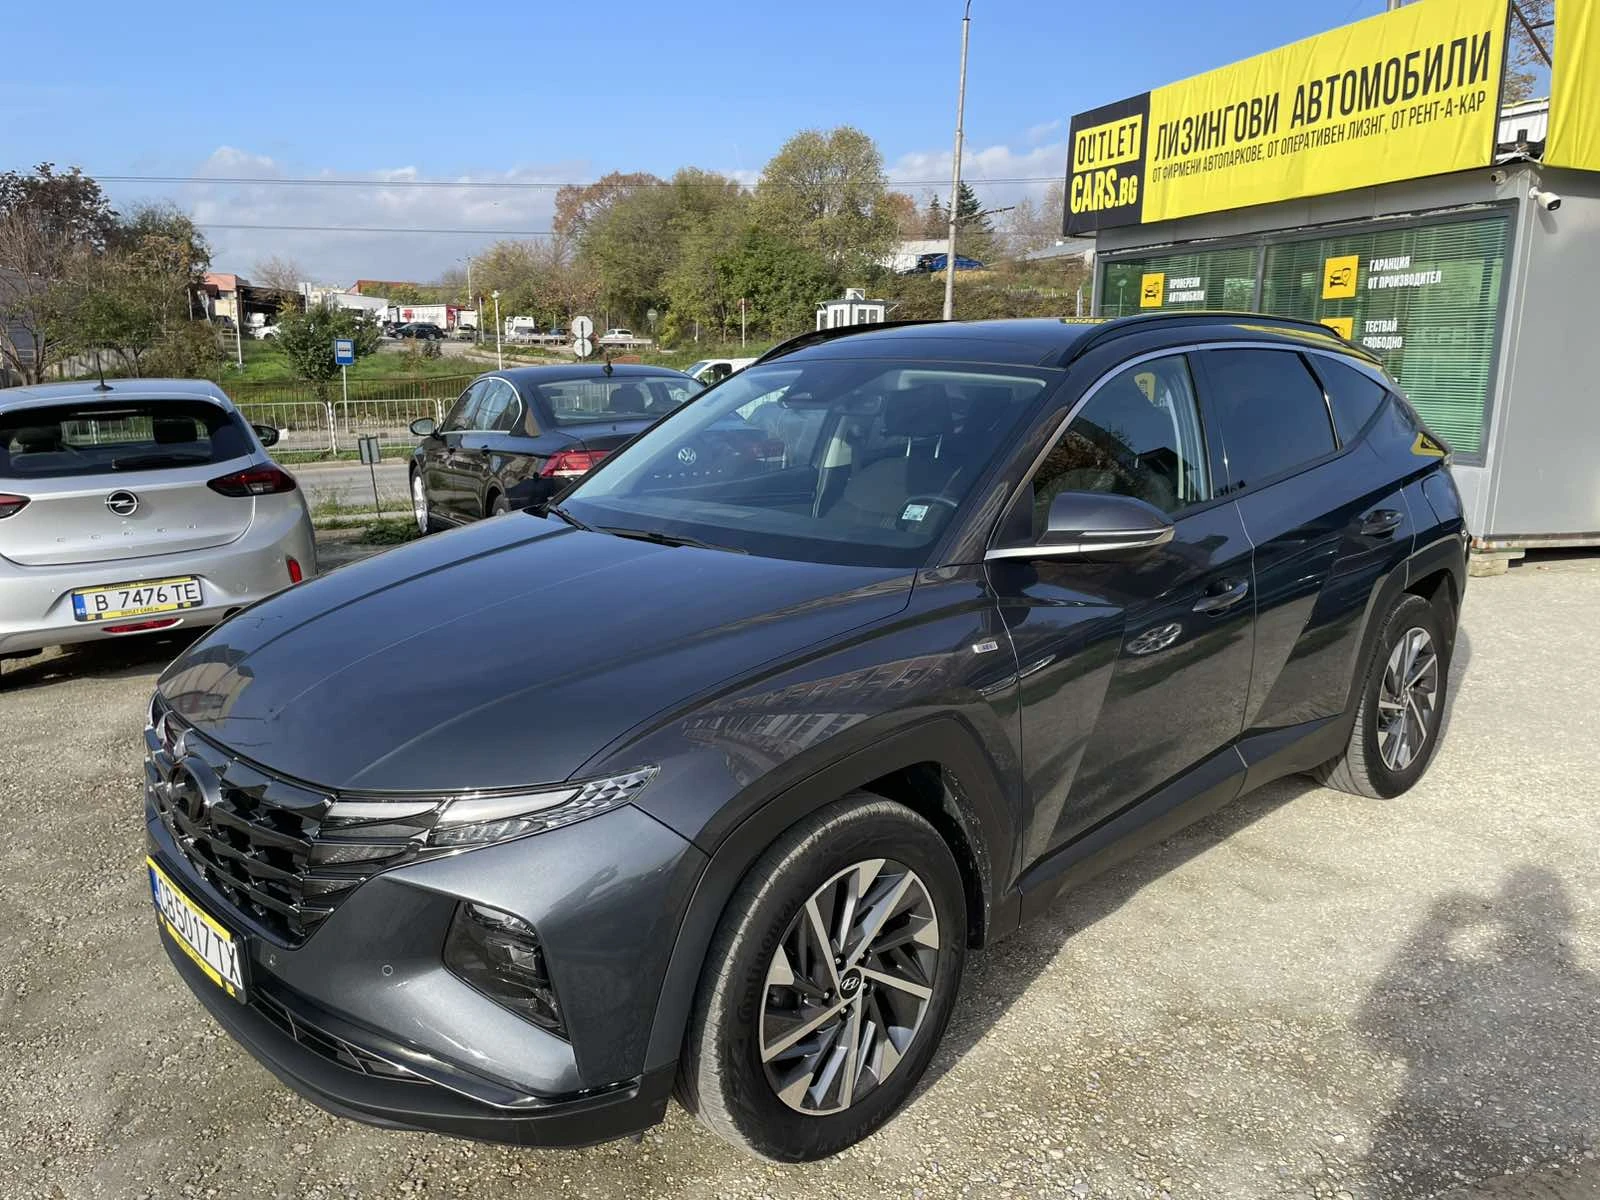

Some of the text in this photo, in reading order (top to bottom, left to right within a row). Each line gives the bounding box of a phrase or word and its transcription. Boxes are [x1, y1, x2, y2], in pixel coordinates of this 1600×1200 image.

[1154, 30, 1491, 162] ЛИЗИНГОВИ АВТОМОБИЛИ
[1077, 122, 1138, 166] OUTLET
[1152, 166, 1162, 183] ОТ
[1163, 161, 1201, 180] ФИРМЕНИ
[1202, 143, 1264, 173] АВТОПАРКОВЕ,
[1267, 139, 1279, 158] ОТ
[1280, 123, 1346, 155] ОПЕРАТИВЕН
[1391, 108, 1407, 130] ОТ
[1408, 90, 1486, 127] РЕНТ-А-КАР
[1070, 167, 1138, 215] CARS.BG
[1367, 270, 1442, 290] ОТ ПРОИЗВОДИТЕЛ
[1369, 255, 1411, 273] ГАРАНЦИЯ
[1365, 317, 1398, 333] ТЕСТВАЙ
[95, 594, 109, 612] B
[119, 587, 168, 608] 7476
[170, 583, 198, 601] TE
